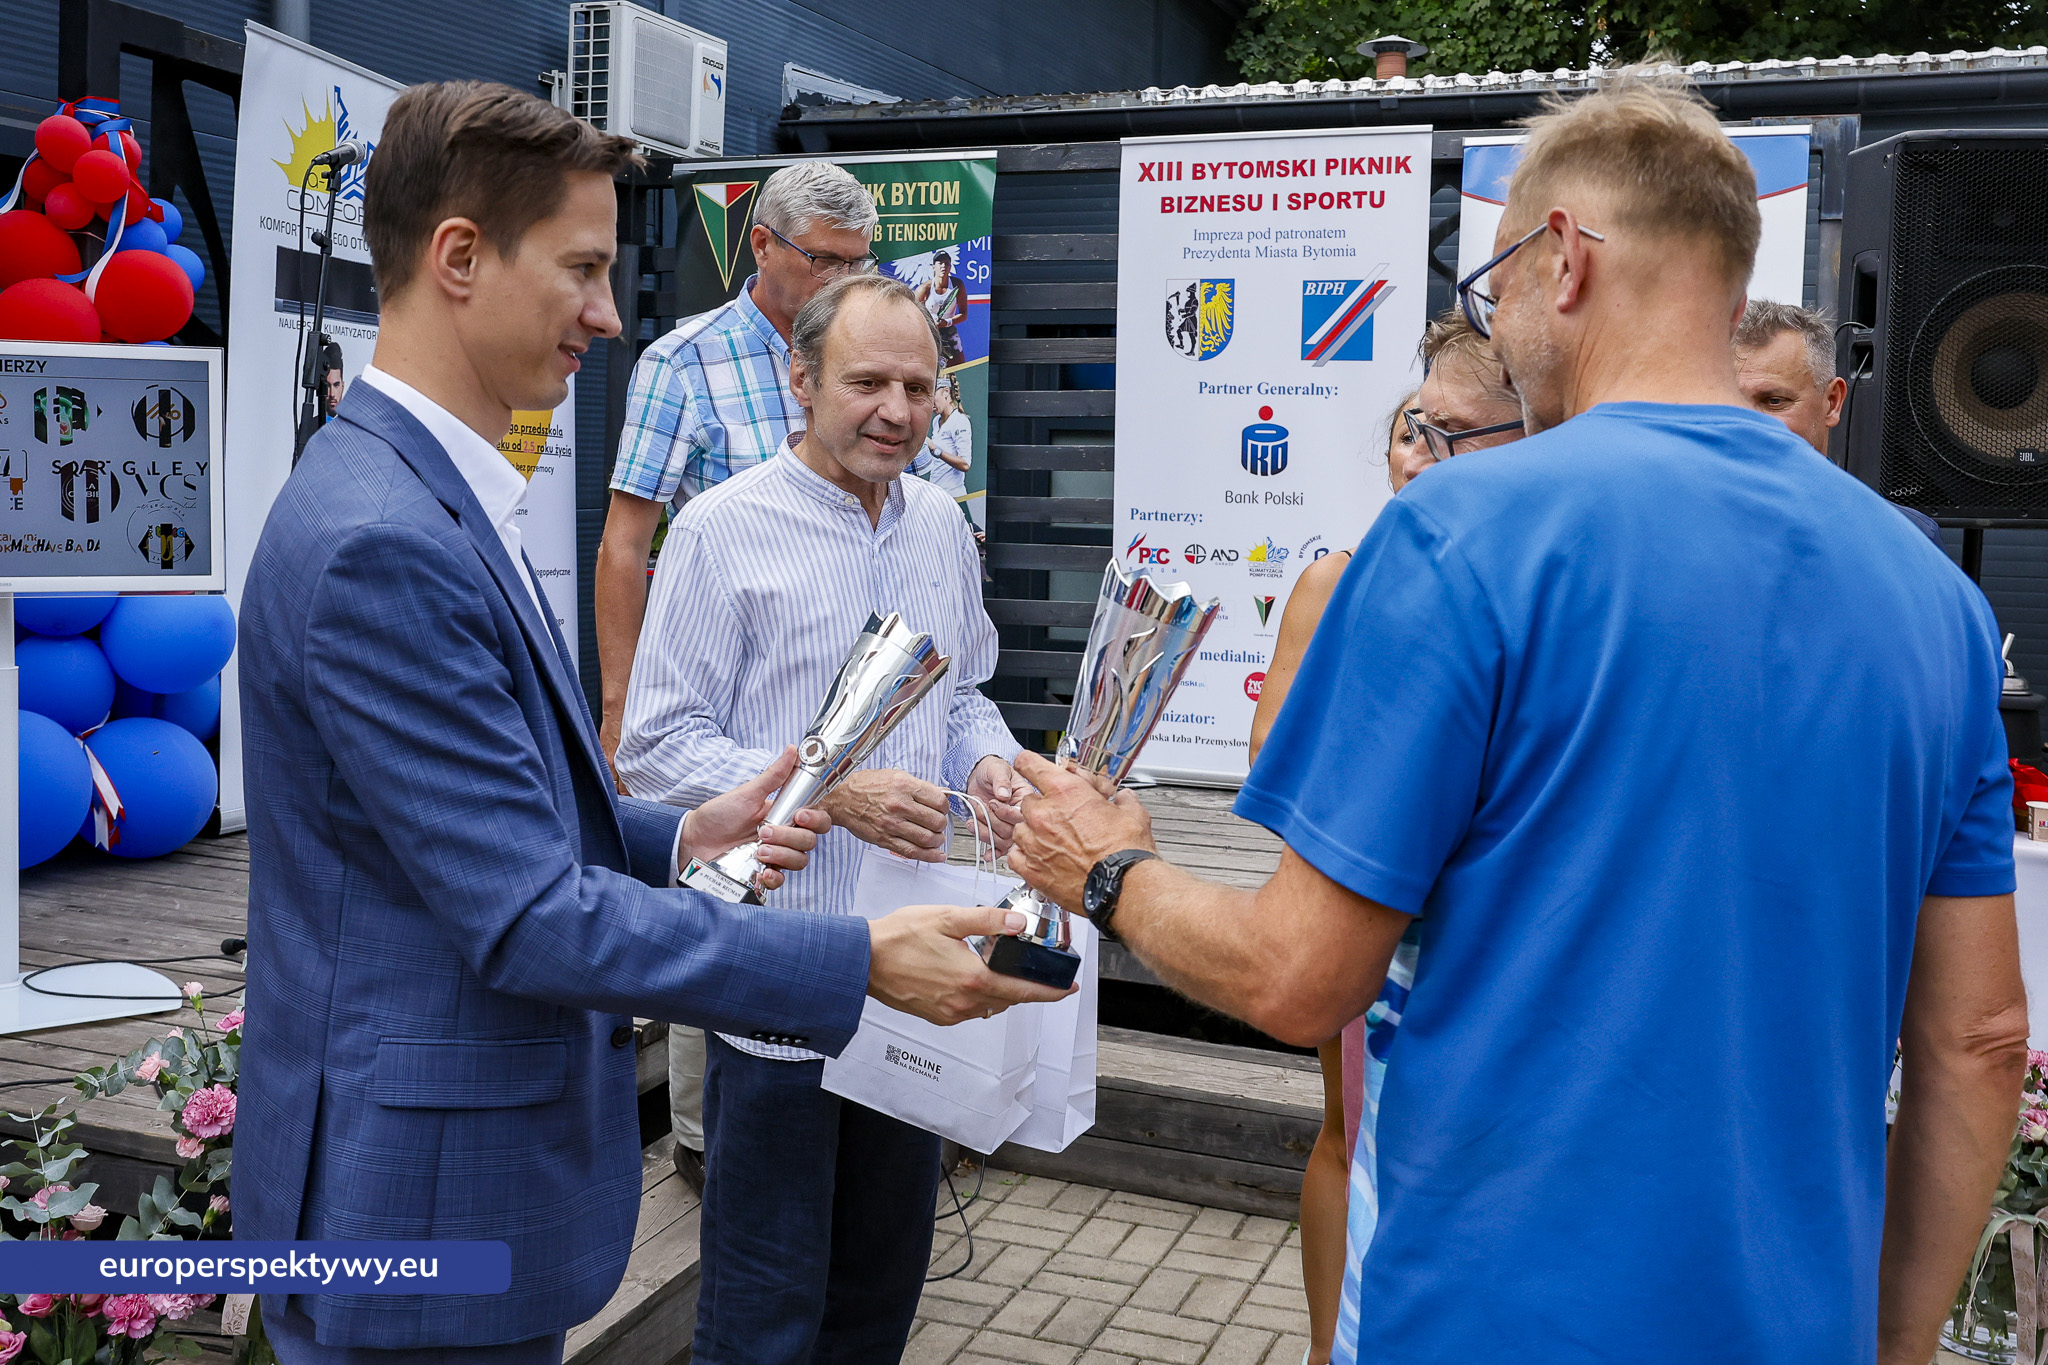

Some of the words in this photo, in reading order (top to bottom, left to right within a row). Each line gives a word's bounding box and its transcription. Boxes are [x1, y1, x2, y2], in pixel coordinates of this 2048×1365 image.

[1137, 161, 1183, 182] XIII
[1191, 159, 1316, 181] BYTOMSKI
[1325, 155, 1412, 177] PIKNIK
[891, 180, 960, 206] BYTOM
[1160, 193, 1263, 214] BIZNESU
[1272, 193, 1279, 211] I
[1287, 190, 1386, 211] SPORTU
[886, 222, 958, 242] TENISOWY
[1193, 228, 1244, 244] Impreza
[1247, 227, 1271, 243] pod
[1275, 228, 1346, 243] patronatem
[1182, 246, 1251, 262] Prezydenta
[1254, 245, 1298, 258] Miasta
[1302, 244, 1356, 261] Bytomia
[966, 259, 990, 284] Sp
[1304, 281, 1347, 296] BIPH
[1198, 381, 1253, 395] Partner
[1257, 381, 1339, 399] Generalny:
[521, 422, 563, 437] przedszkola
[512, 439, 522, 451] od
[537, 441, 554, 453] roku
[555, 444, 572, 458] życia
[2019, 452, 2035, 462] JBL
[527, 465, 554, 475] przemocy
[1225, 490, 1259, 505] Bank
[1264, 491, 1304, 506] Polski
[1130, 507, 1203, 526] Partnerzy:
[1138, 547, 1170, 565] PEC
[1210, 549, 1239, 562] AND
[1200, 649, 1266, 664] medialni:
[1172, 734, 1192, 744] Izba
[901, 1051, 942, 1075] ONLINE
